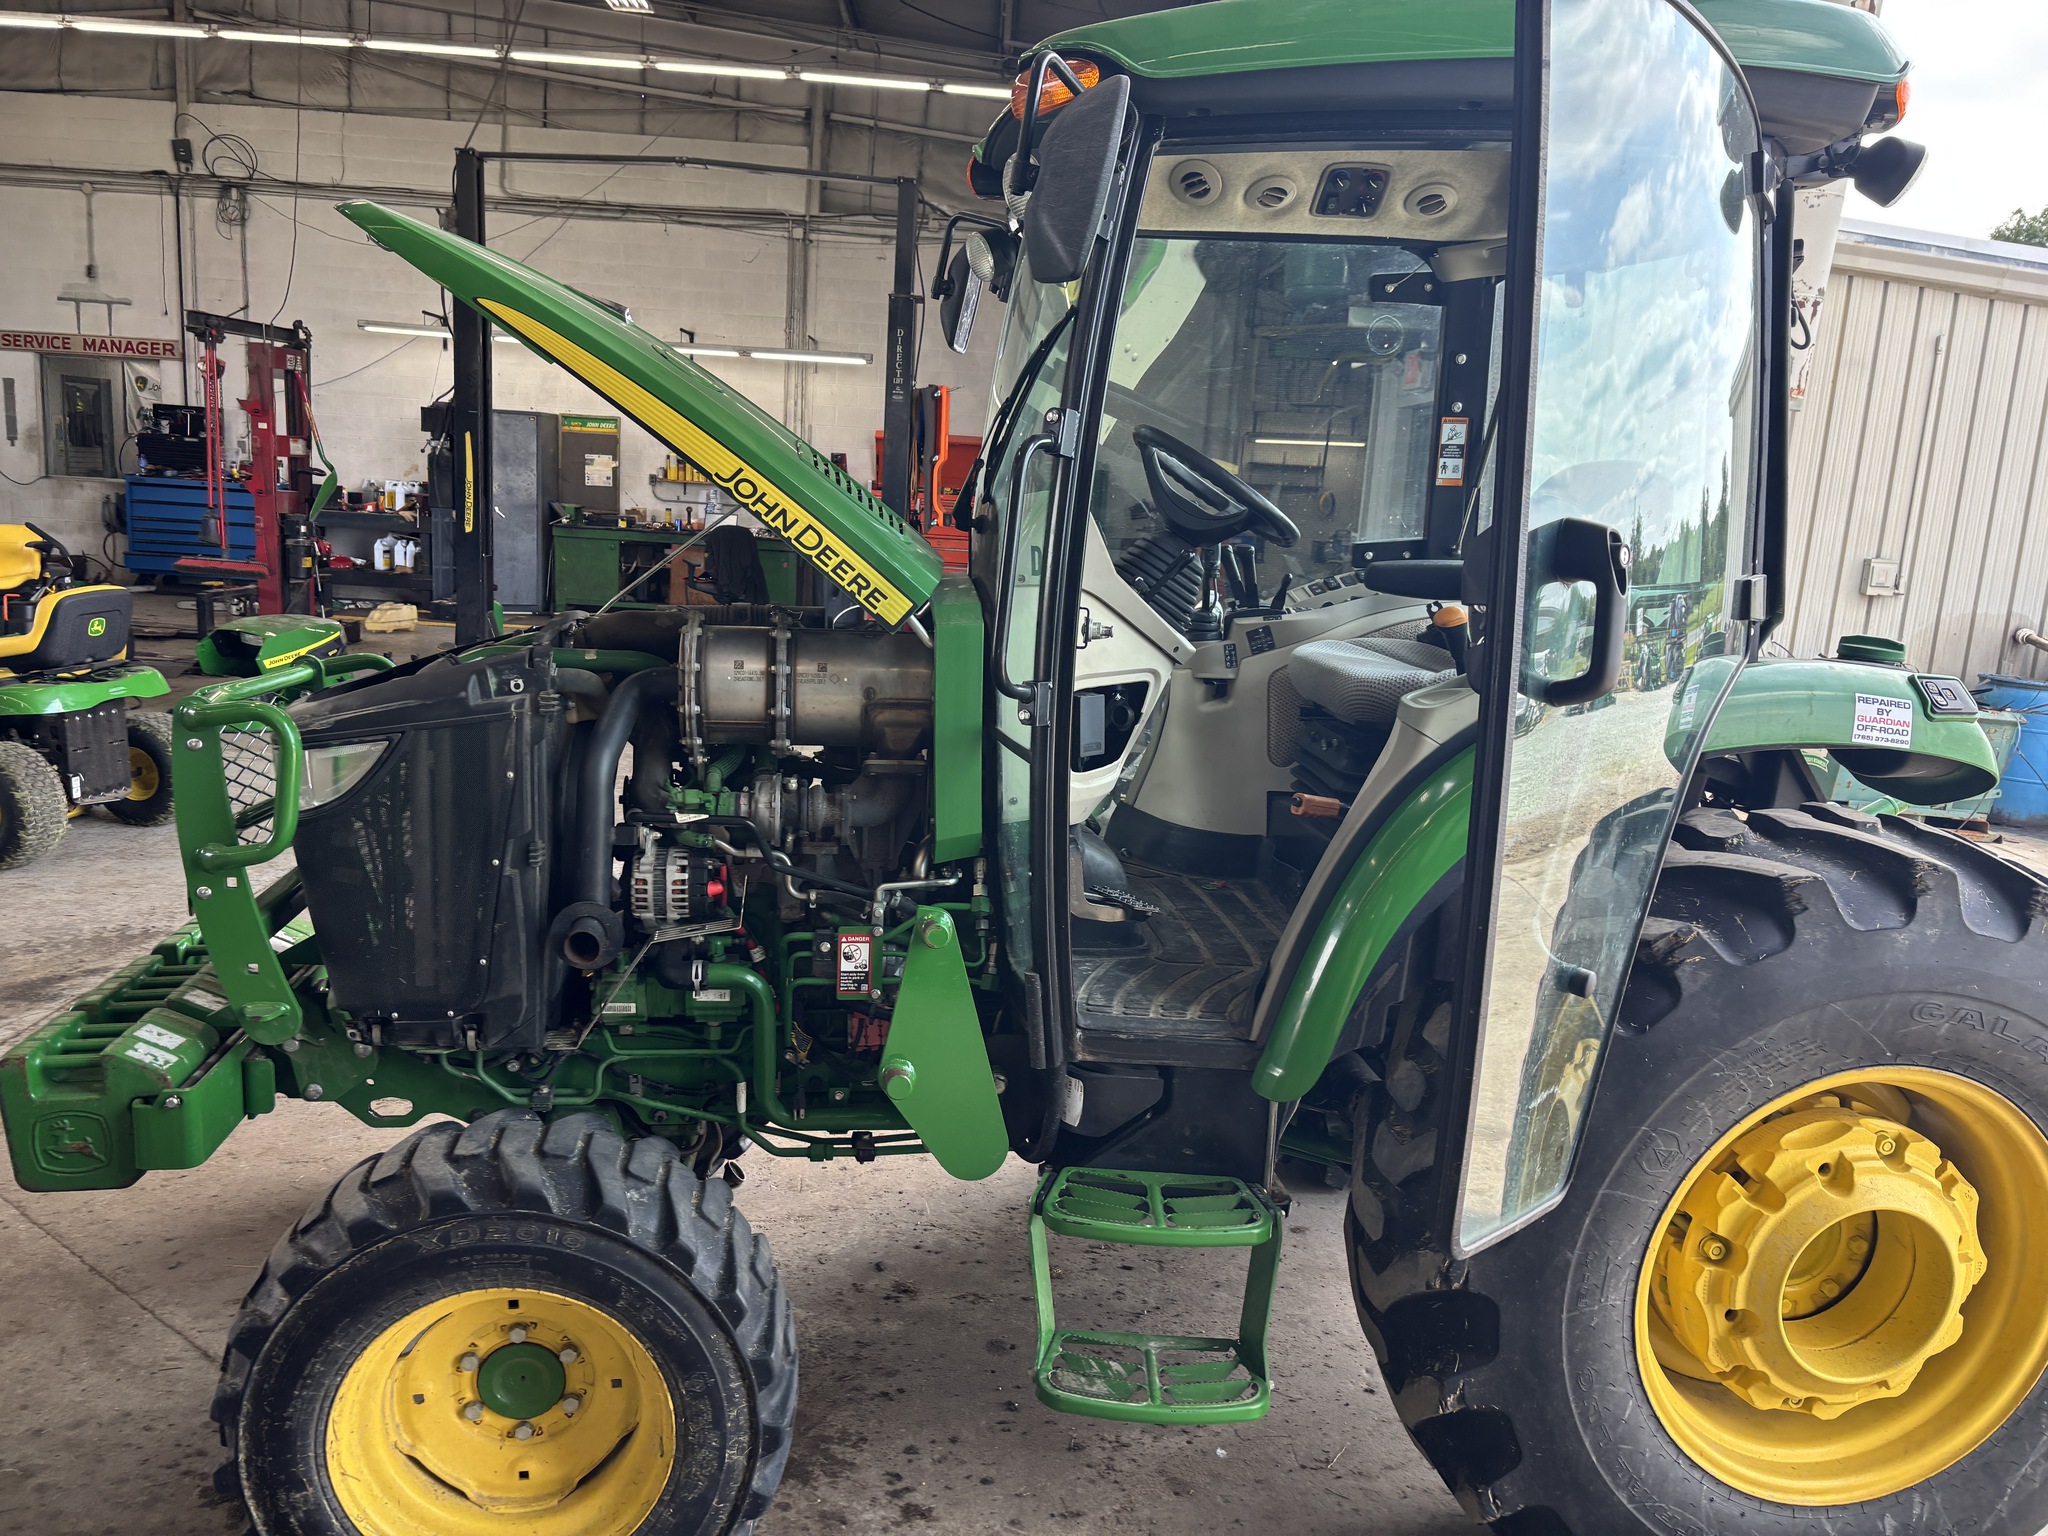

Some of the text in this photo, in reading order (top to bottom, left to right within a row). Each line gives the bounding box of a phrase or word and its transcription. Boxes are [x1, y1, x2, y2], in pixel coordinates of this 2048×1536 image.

[1, 333, 176, 357] SERVICE MANAGER
[895, 328, 904, 378] DIRECT
[465, 477, 473, 527] JOHN DEERE
[713, 467, 889, 611] JOHN DEERE
[268, 651, 301, 666] JOHN DEERE
[1857, 695, 1911, 710] REPAIRED
[1876, 707, 1893, 717] BY
[1856, 714, 1911, 729] GUARDIAN
[1856, 723, 1909, 737] OFF-ROAD
